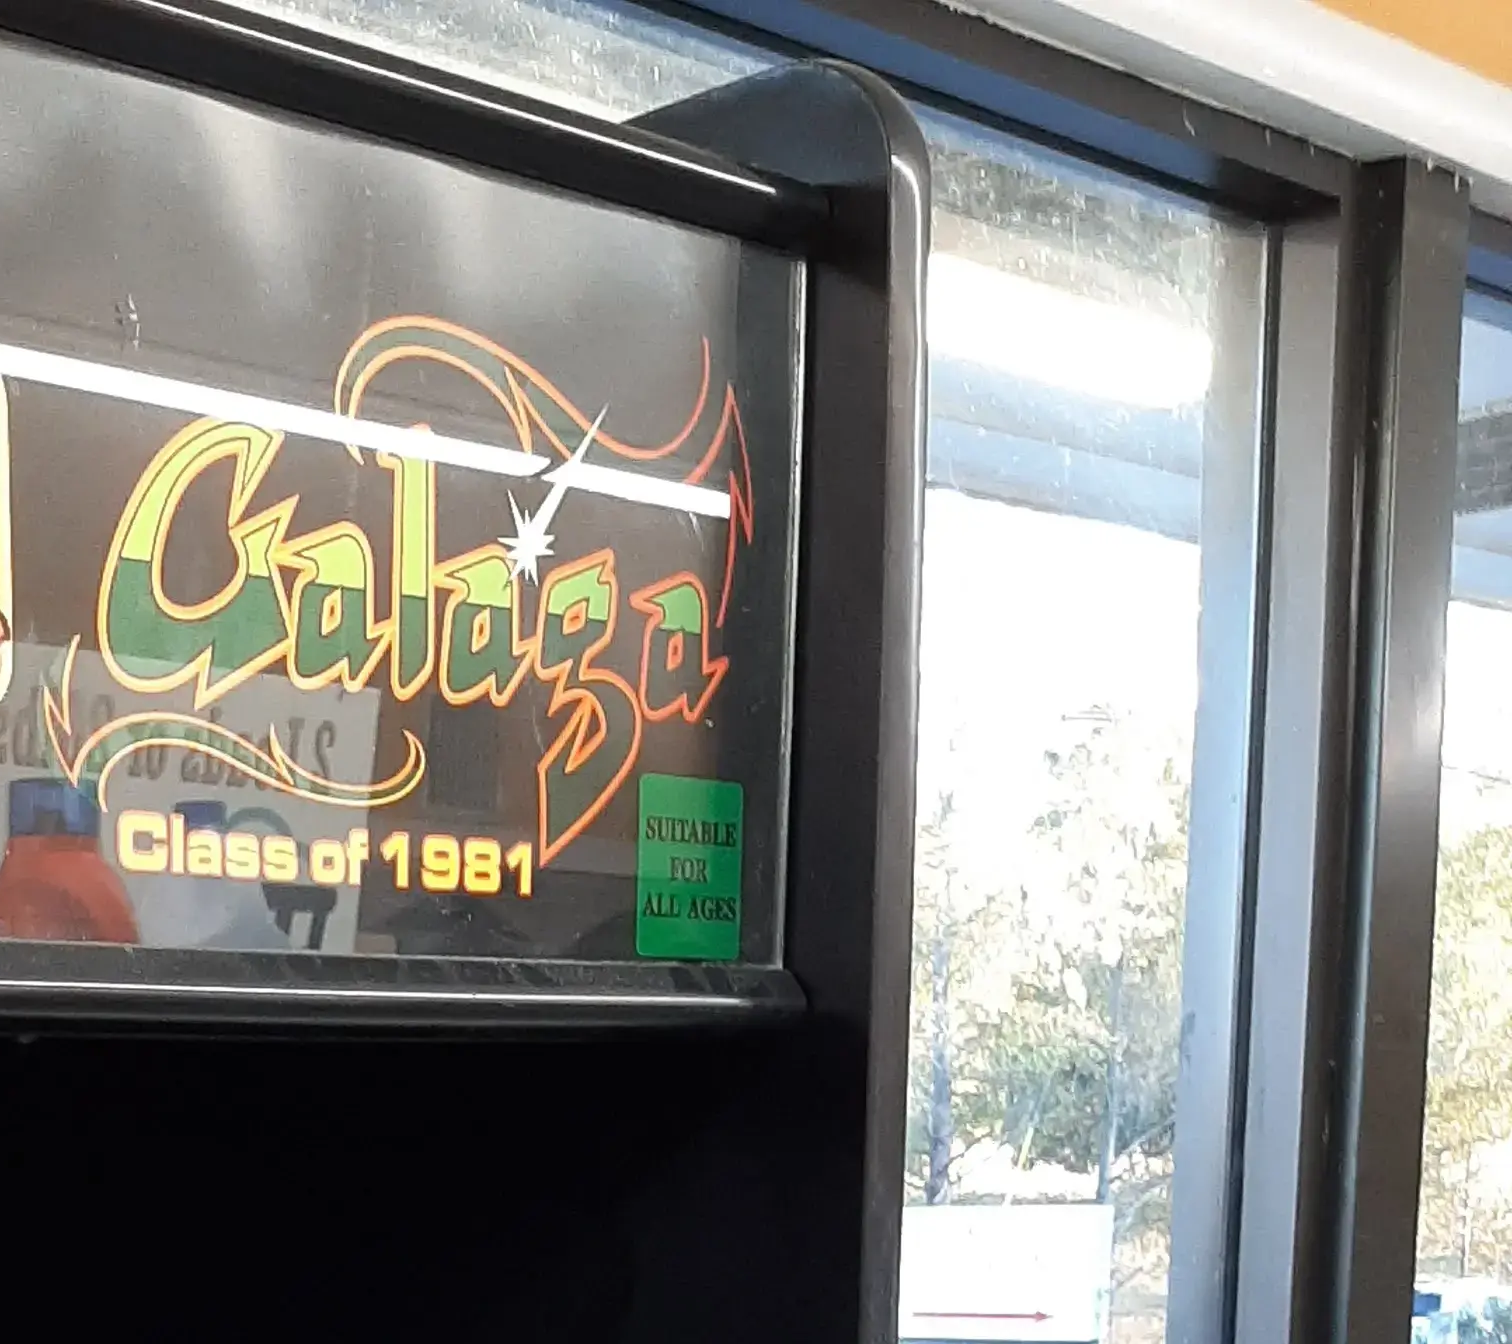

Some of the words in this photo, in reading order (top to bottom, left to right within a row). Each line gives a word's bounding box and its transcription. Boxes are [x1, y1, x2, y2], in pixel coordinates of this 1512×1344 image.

[645, 815, 736, 848] SUITABLE
[117, 809, 299, 884] Class
[310, 828, 369, 887] of
[379, 829, 533, 897] 1981
[668, 855, 709, 884] FOR
[643, 892, 681, 918] ALL
[687, 894, 737, 922] AGES
